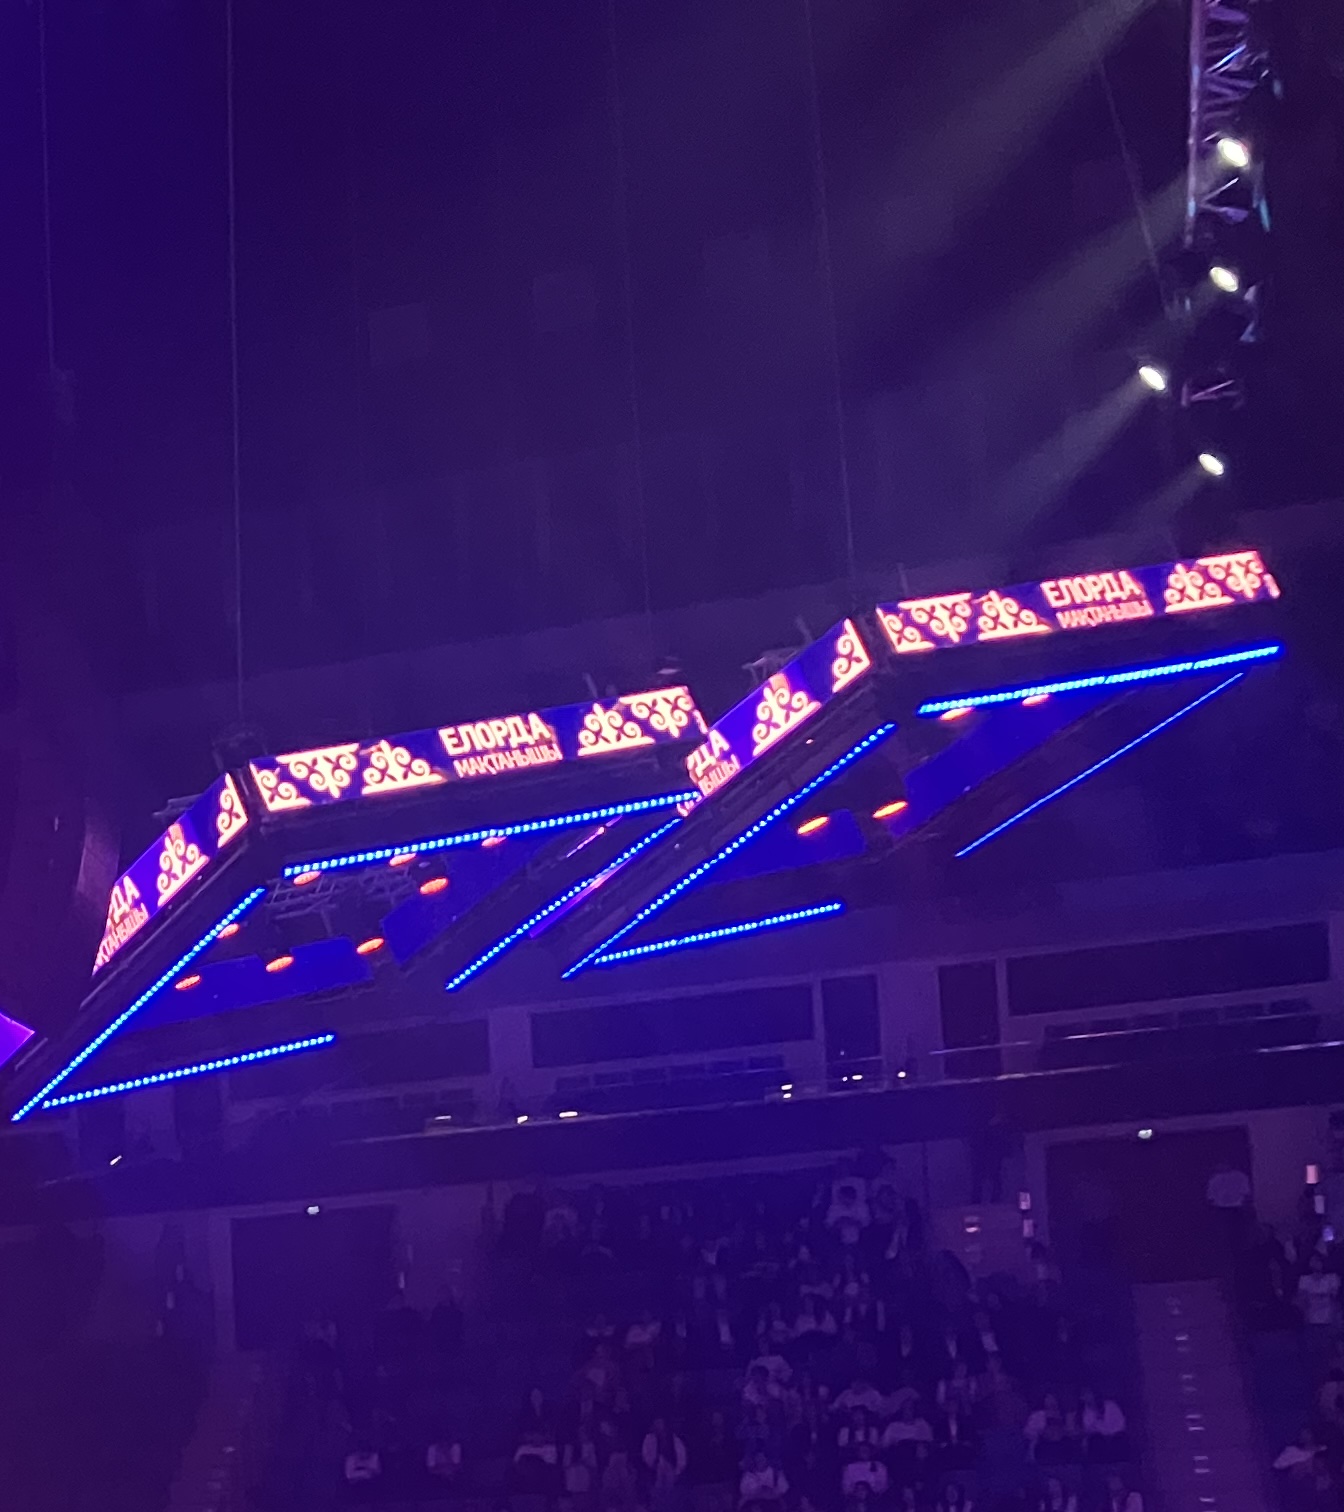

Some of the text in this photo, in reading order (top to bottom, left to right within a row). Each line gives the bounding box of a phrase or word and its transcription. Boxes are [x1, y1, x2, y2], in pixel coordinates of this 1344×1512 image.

[1040, 570, 1142, 608] ЕЛОРДА
[438, 712, 551, 756] ЕЛОРДА
[453, 743, 563, 778] МАҚТАНЫШЫ
[107, 875, 140, 926] ДА
[92, 902, 149, 975] ҚТАНЫШЫ
